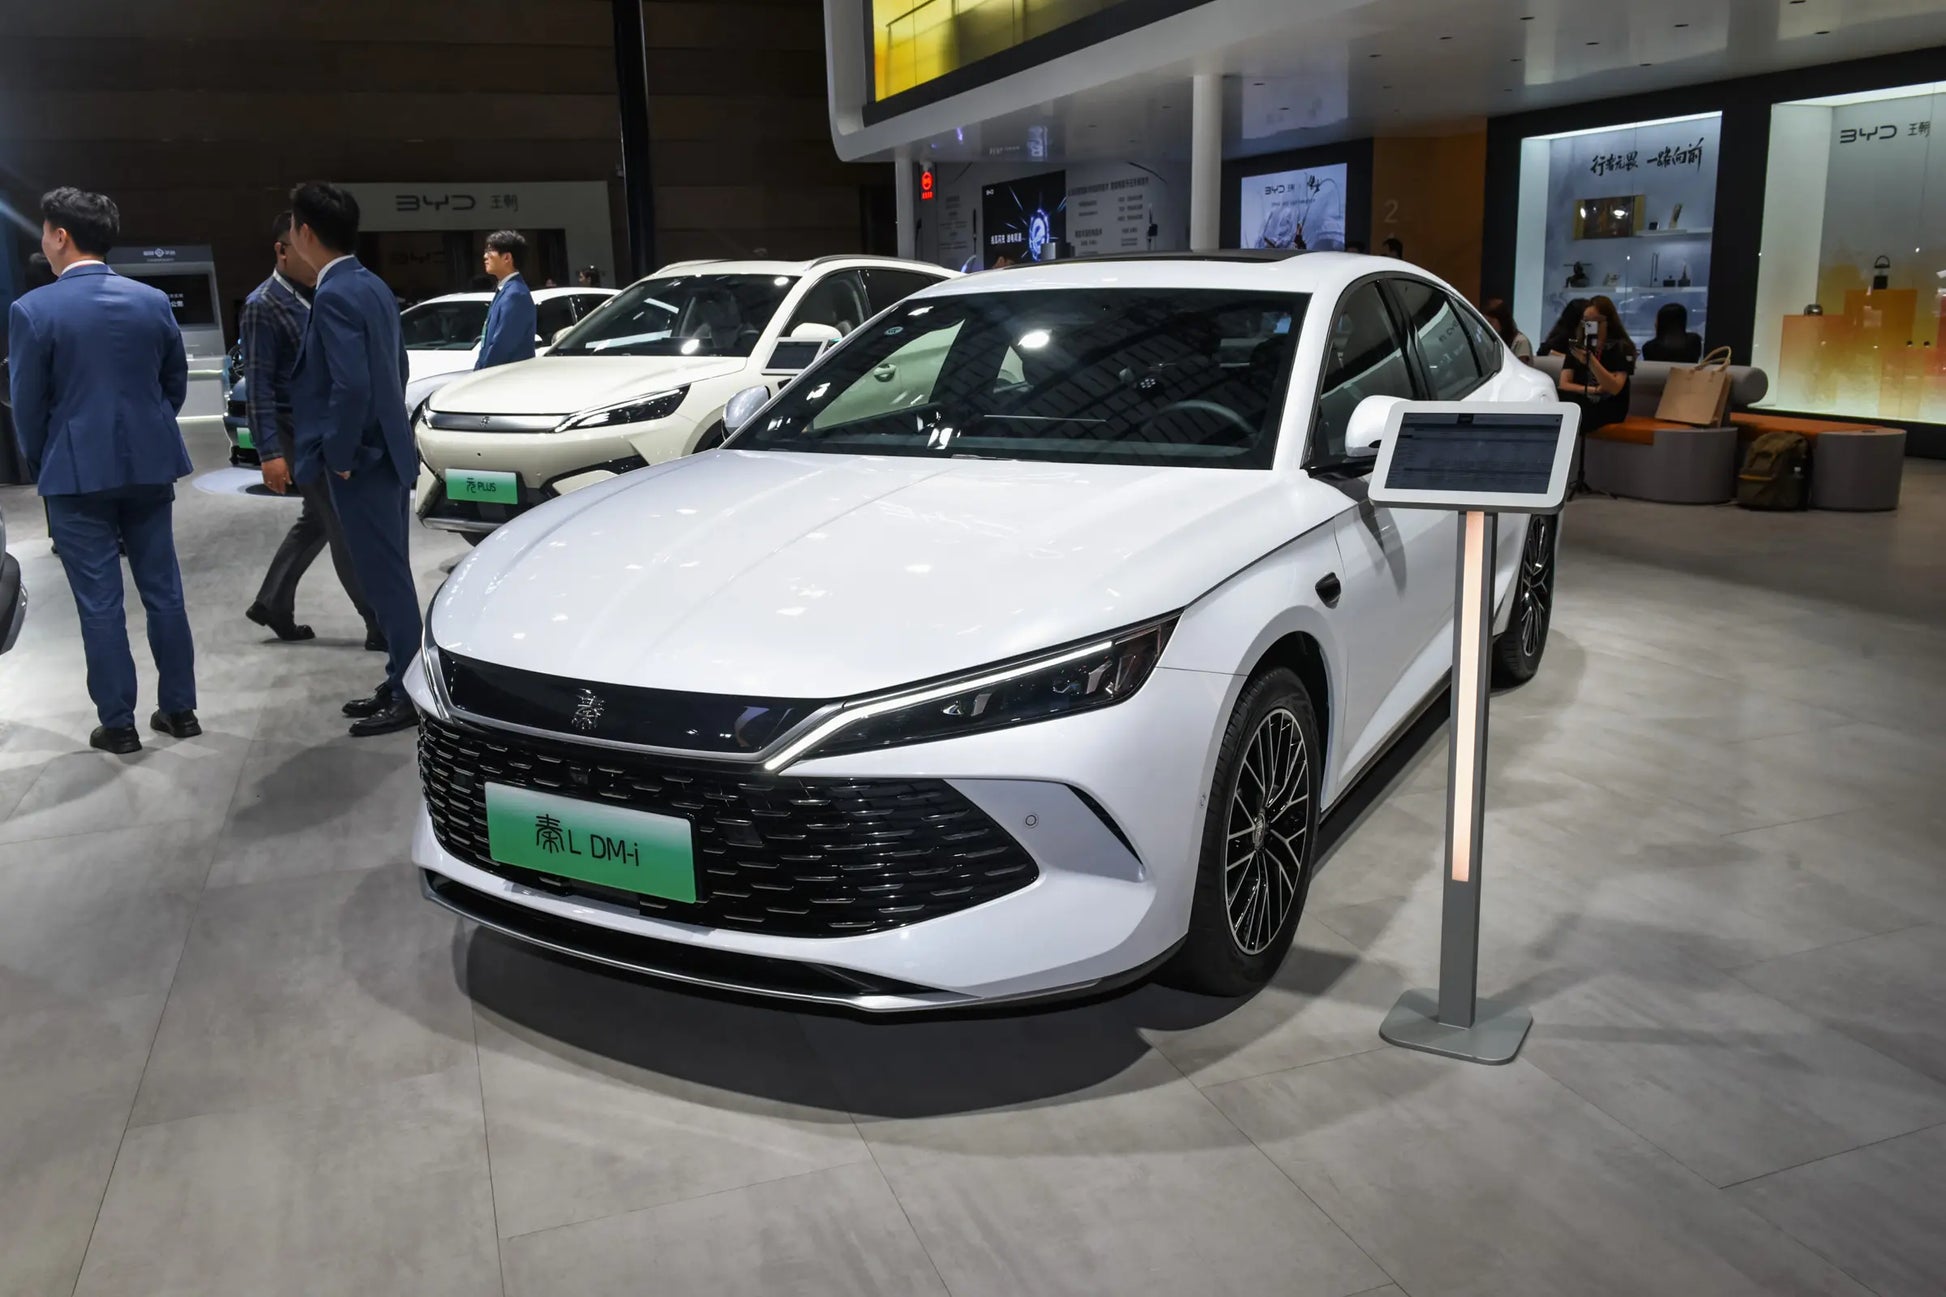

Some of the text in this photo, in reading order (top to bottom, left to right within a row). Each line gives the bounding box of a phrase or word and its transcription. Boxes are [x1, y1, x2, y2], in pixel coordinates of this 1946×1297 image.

[1840, 121, 1931, 144] BYD 王朝
[1646, 137, 1704, 173] 一路向前
[395, 194, 519, 212] BYD 王朝
[589, 833, 640, 867] DM-i
